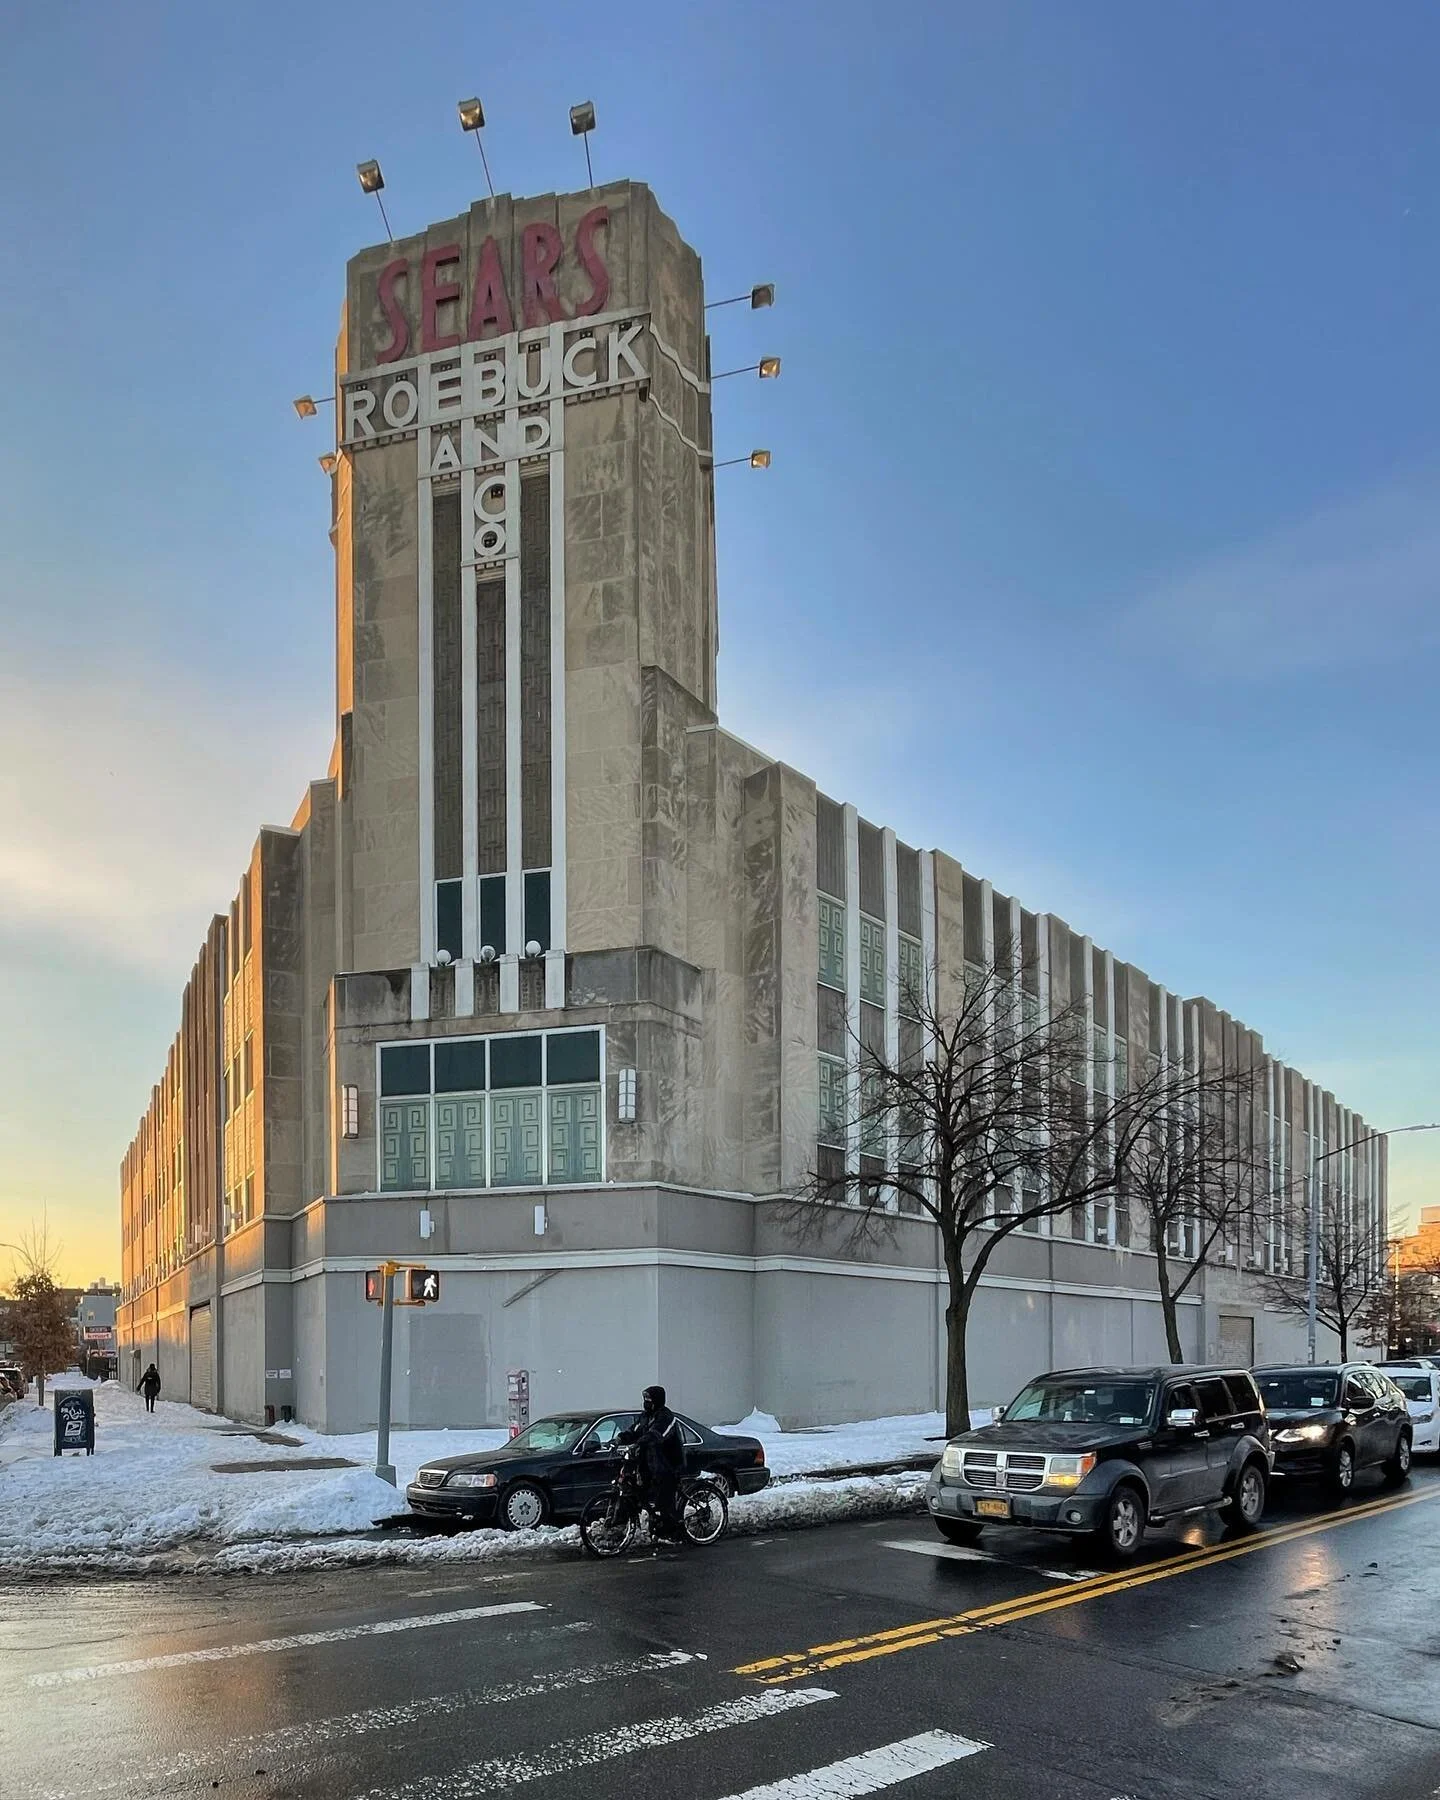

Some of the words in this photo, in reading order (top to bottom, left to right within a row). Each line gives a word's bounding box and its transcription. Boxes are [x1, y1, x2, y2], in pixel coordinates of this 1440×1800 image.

[376, 206, 609, 366] SEARS
[346, 325, 651, 441] ROEBUCK
[431, 415, 551, 471] AND
